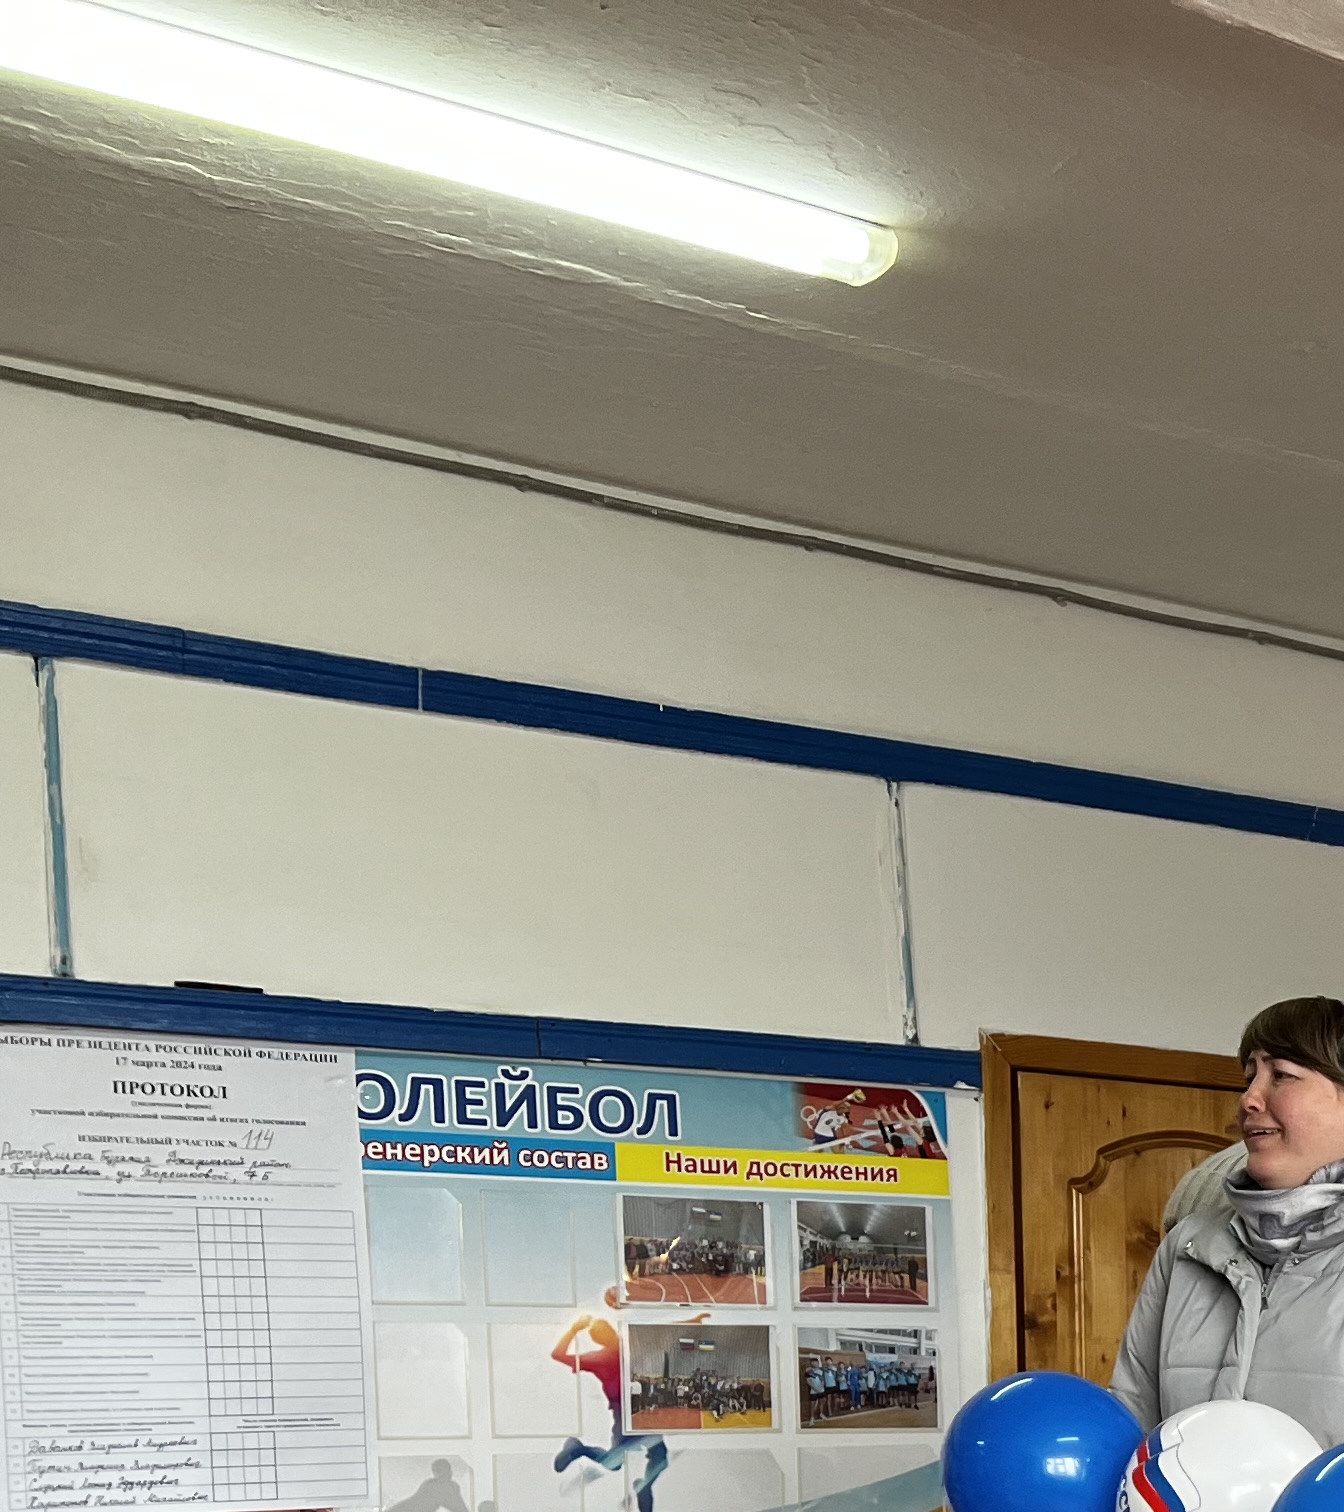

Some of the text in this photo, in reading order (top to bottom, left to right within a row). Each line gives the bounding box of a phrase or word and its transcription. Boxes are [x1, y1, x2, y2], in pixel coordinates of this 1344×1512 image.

[56, 1038, 151, 1053] ПРЕЗИДЕНТА
[154, 1043, 252, 1058] РОССИЙСКОЙ
[255, 1049, 338, 1064] ФЕДЕРАЦИИ
[115, 1056, 223, 1072] 17 марта 2024 года
[112, 1080, 228, 1099] ПРОТОКОЛ
[77, 1134, 173, 1146] ИЗБИРАТЕЛЬНЫЙ
[175, 1138, 225, 1148] УЧАСТОК
[242, 1128, 275, 1149] 114
[0, 1141, 94, 1166] Республика
[517, 1147, 609, 1171] состав
[664, 1151, 899, 1185] Наши достижения
